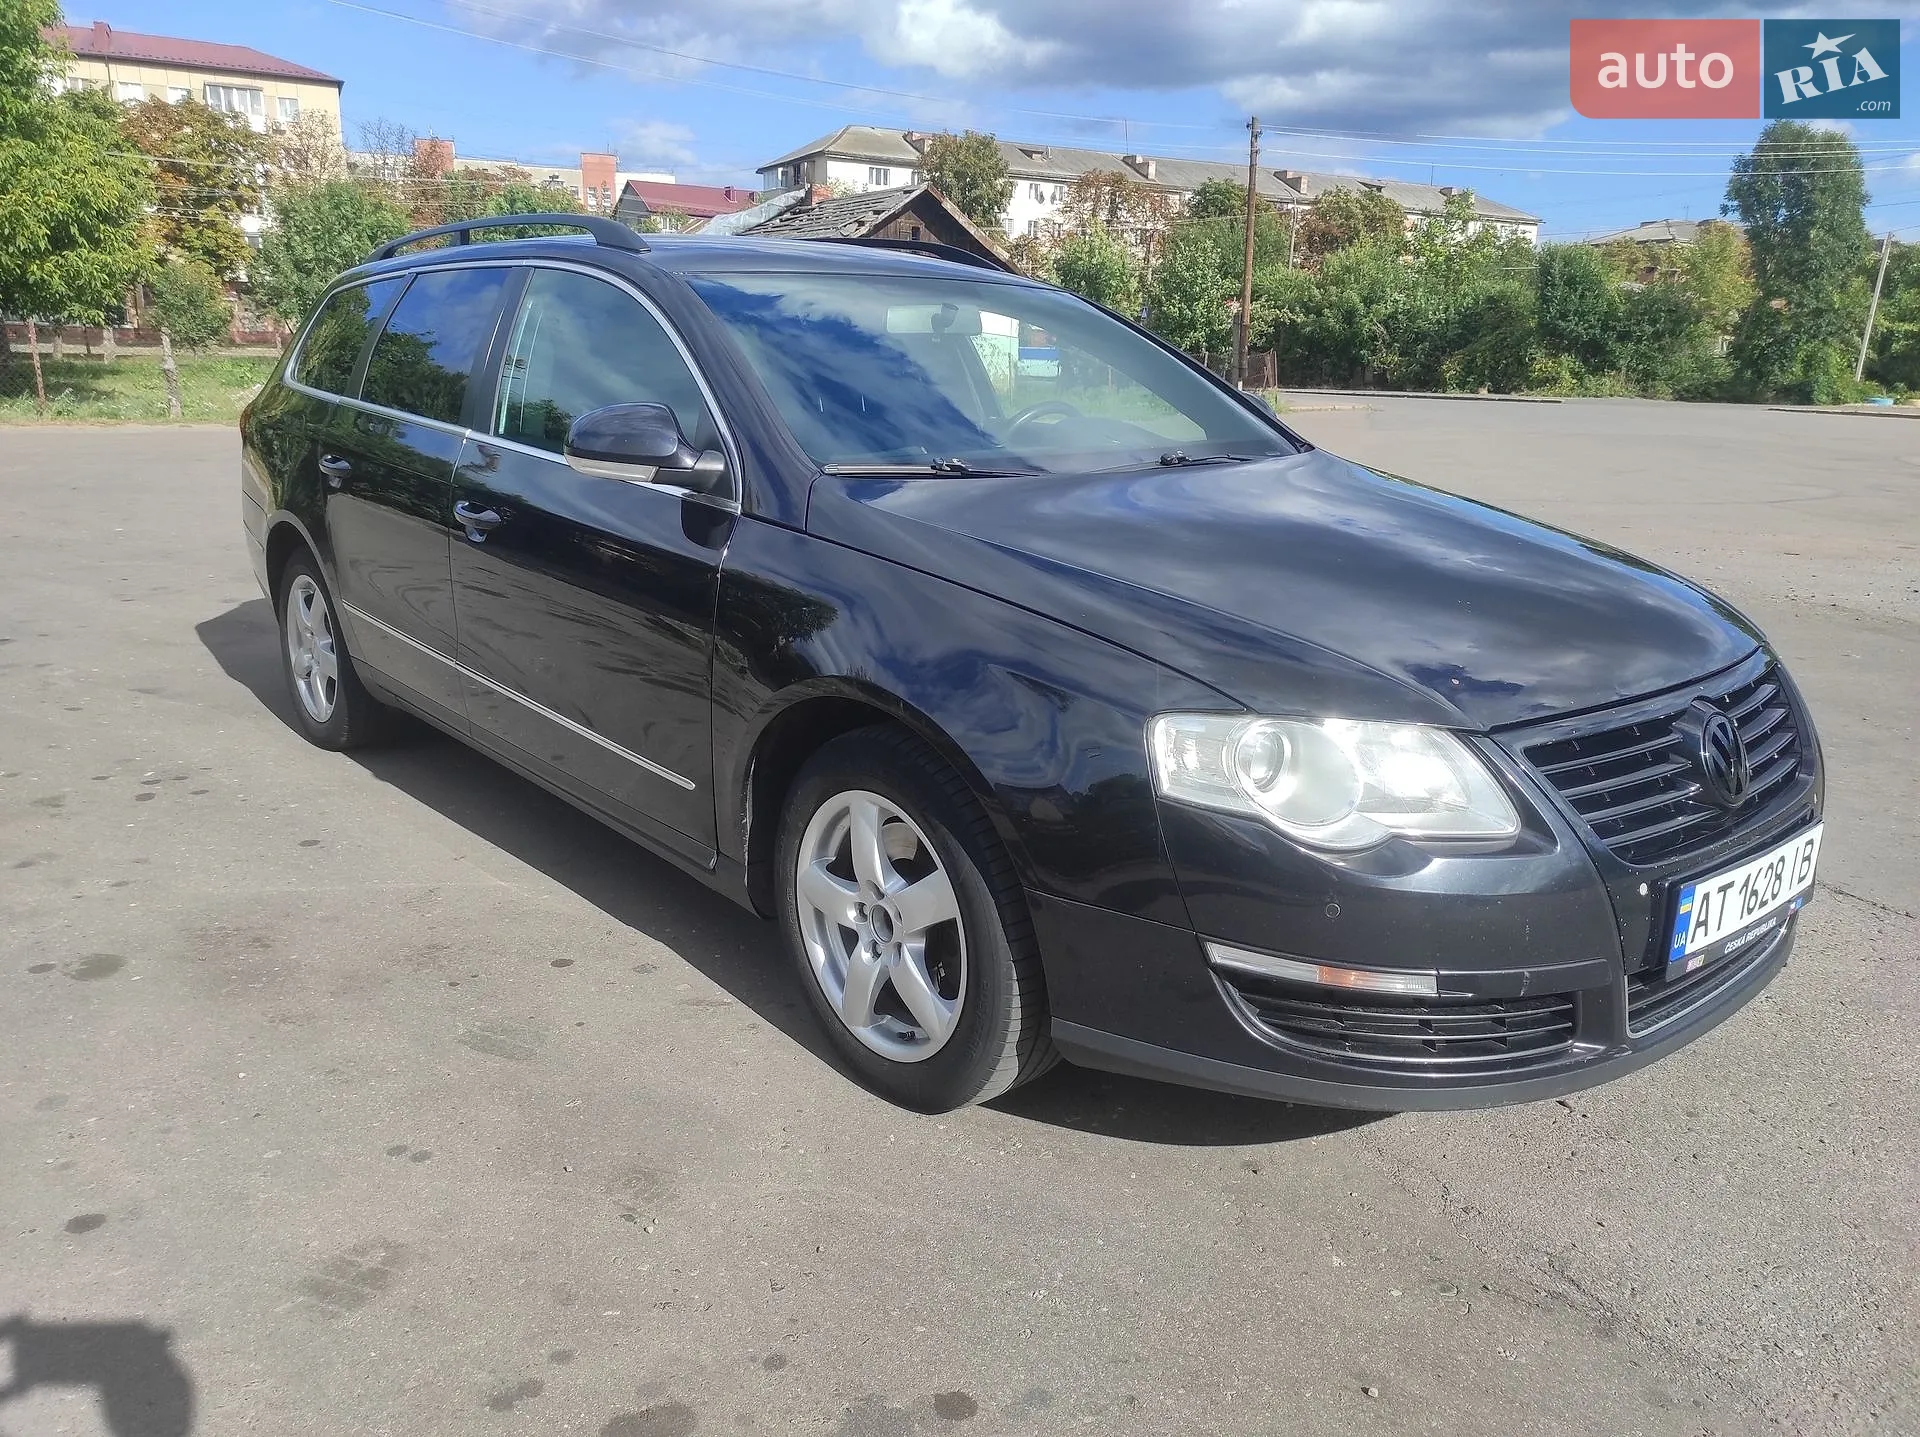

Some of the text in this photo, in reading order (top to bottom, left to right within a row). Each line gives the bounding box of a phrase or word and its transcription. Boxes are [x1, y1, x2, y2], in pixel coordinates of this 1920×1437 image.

[1690, 838, 1815, 944] AT 1628 IB
[1673, 932, 1686, 949] UA
